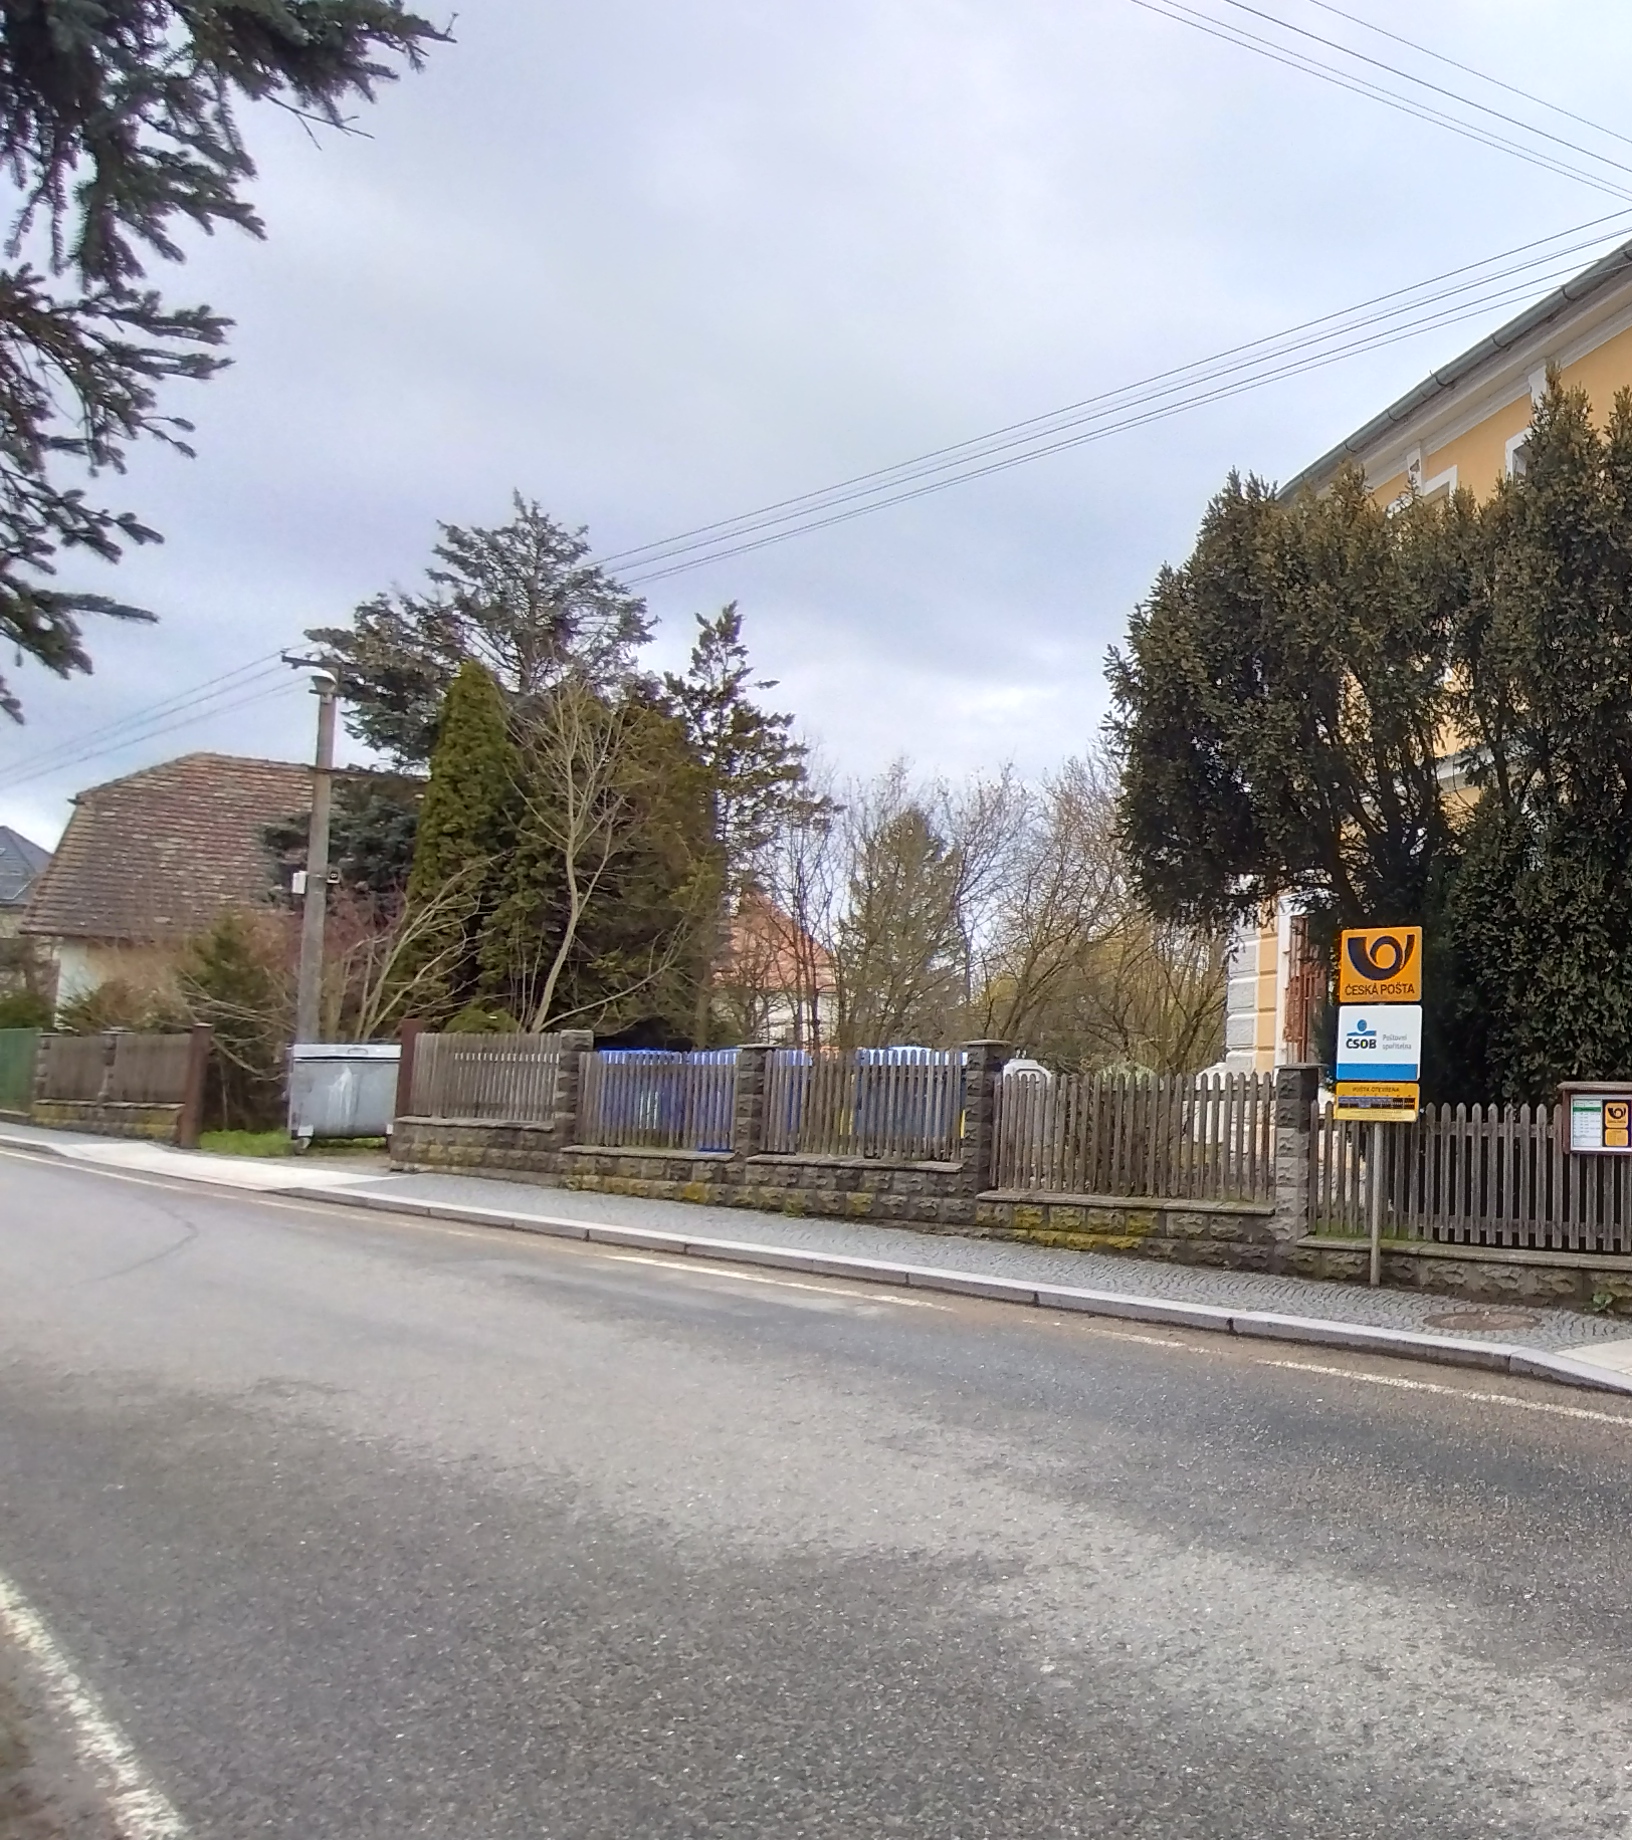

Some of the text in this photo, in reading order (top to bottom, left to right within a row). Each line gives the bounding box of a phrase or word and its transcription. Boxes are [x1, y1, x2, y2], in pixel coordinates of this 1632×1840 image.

[1344, 982, 1415, 996] ČESKÁ POŠTA
[1346, 1038, 1377, 1050] ČSOB
